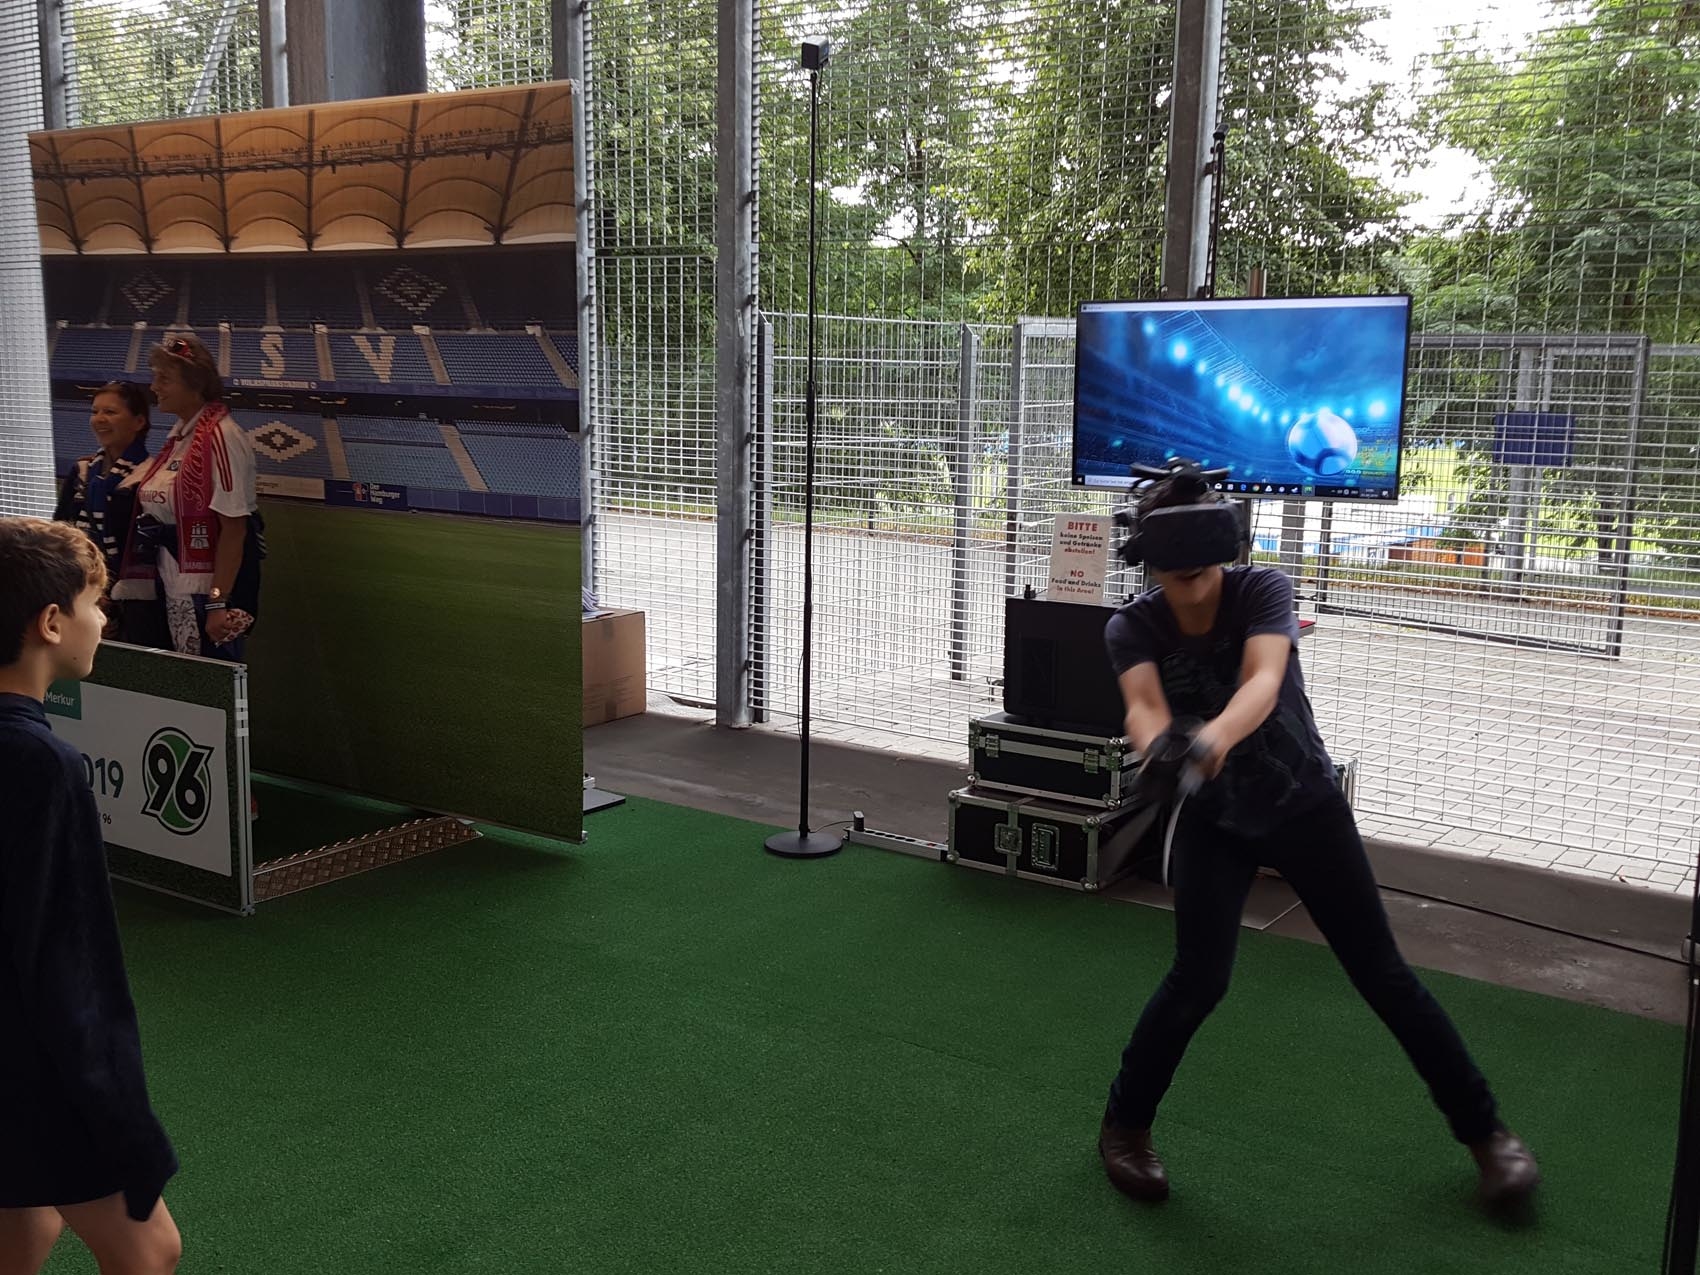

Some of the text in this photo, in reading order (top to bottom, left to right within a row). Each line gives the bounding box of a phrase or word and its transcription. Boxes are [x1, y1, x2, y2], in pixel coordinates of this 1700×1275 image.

[369, 488, 401, 500] Hamburger
[1067, 521, 1098, 532] BITTE
[1078, 533, 1103, 541] Speisen
[1070, 570, 1084, 578] NO
[1081, 580, 1101, 588] Drinks
[45, 691, 75, 706] Merkur
[147, 742, 208, 821] 96
[102, 812, 112, 825] 96
